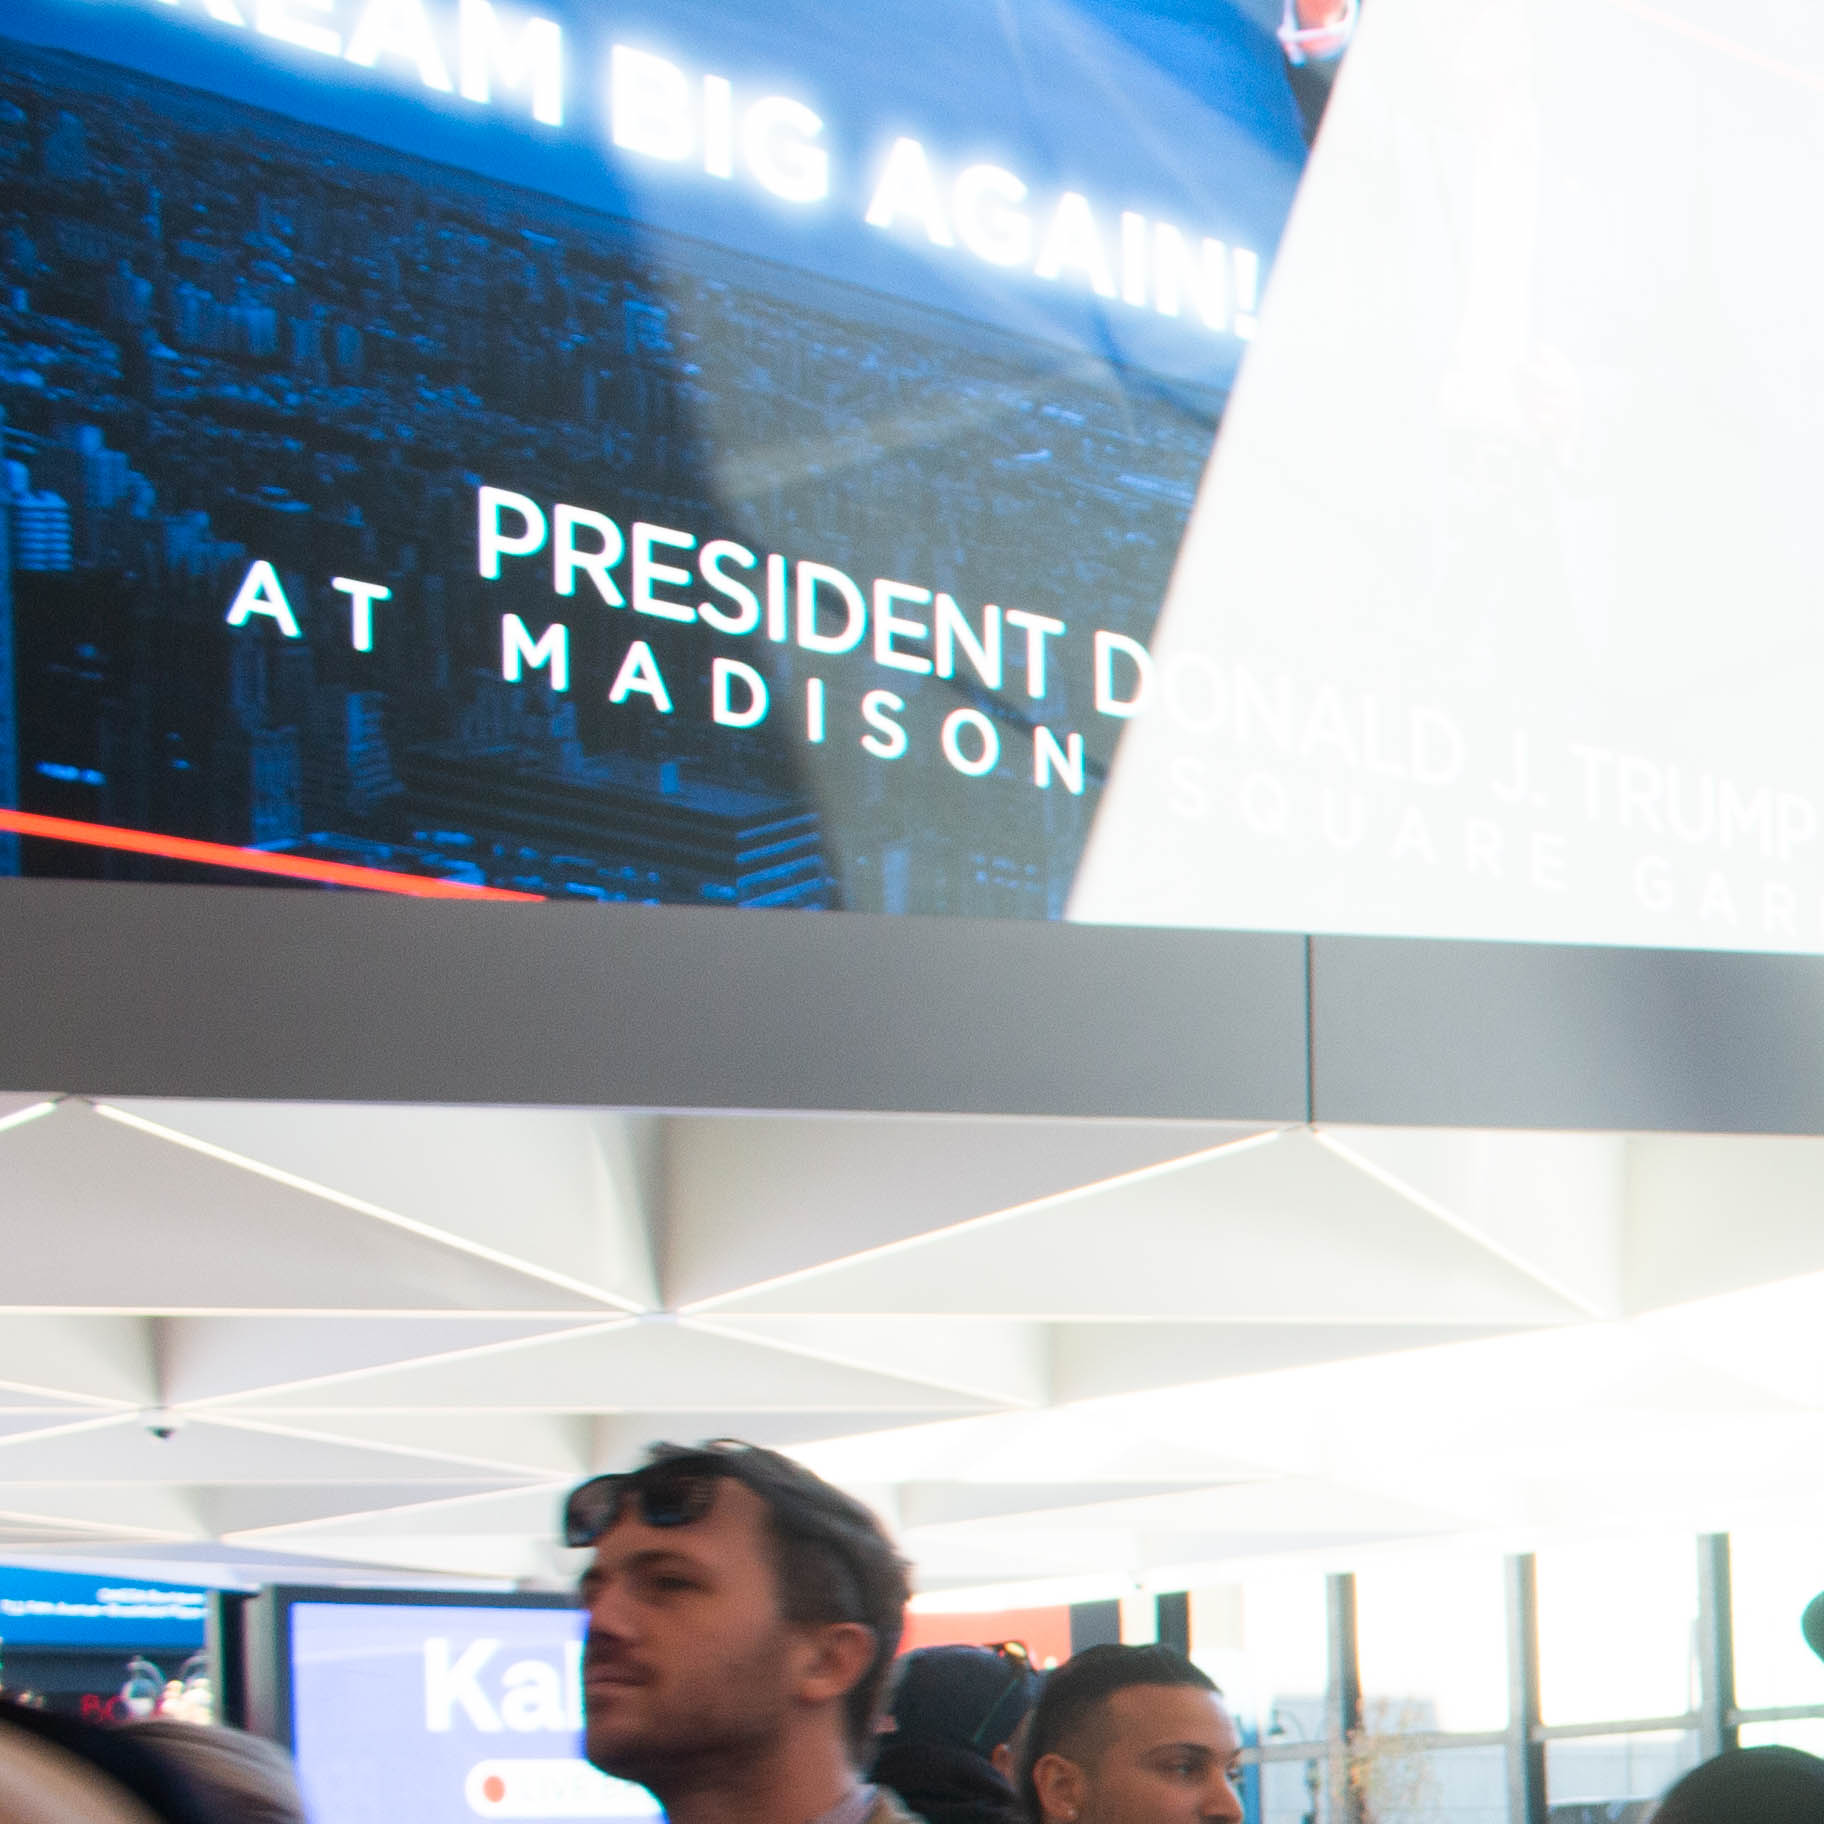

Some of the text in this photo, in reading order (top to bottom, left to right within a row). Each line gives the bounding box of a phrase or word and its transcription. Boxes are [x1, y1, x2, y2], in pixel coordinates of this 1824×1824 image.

[609, 43, 831, 204] BIG
[865, 136, 1261, 341] AGAIN!
[225, 559, 392, 653] AT
[499, 611, 1086, 797] MADISON
[1166, 755, 1569, 891] SQUARE
[477, 484, 1065, 701] PRESIDENT
[1095, 629, 1468, 787] DONALD
[1569, 740, 1818, 865] TRUMP
